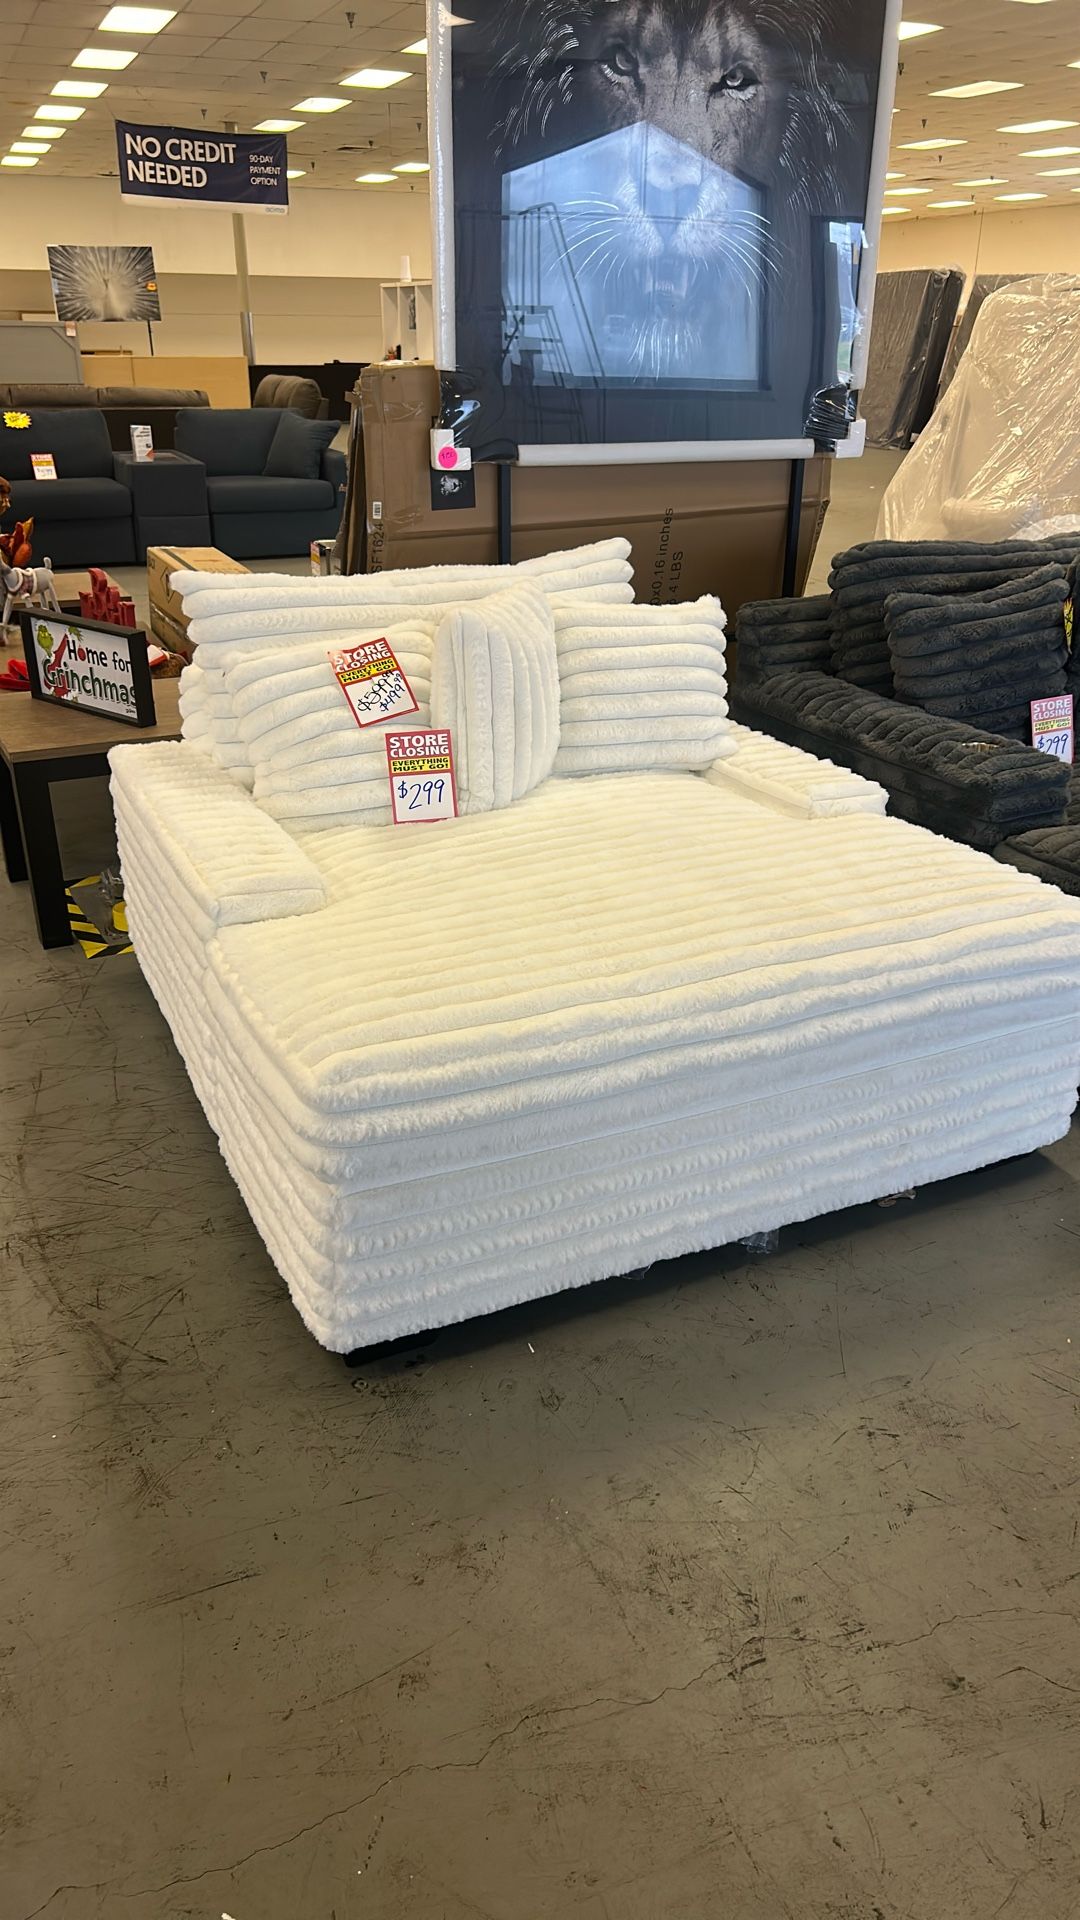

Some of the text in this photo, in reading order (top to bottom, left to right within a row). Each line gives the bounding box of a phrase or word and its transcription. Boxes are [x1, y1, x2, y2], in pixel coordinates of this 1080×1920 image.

[125, 133, 236, 164] NO CREDIT
[249, 155, 273, 164] 90-DAY
[127, 159, 207, 188] NEEDED
[250, 166, 281, 175] PAYMENT
[250, 177, 278, 186] OPTION
[656, 507, 673, 555] inches
[670, 551, 683, 581] LBS
[66, 639, 131, 673] Home for
[333, 641, 387, 665] STORE
[336, 650, 392, 673] CLOSING
[341, 658, 394, 678] EVERYTHING
[343, 663, 395, 683] MUST GO!
[1033, 698, 1071, 713] STORE
[1033, 708, 1072, 720] CLOSING
[1035, 717, 1070, 728] EVERYTHING
[1035, 724, 1054, 732] MUST
[389, 733, 448, 748] STORE
[390, 745, 449, 758] CLOSING
[392, 757, 449, 767] EVERYTHING
[397, 778, 445, 810] $299
